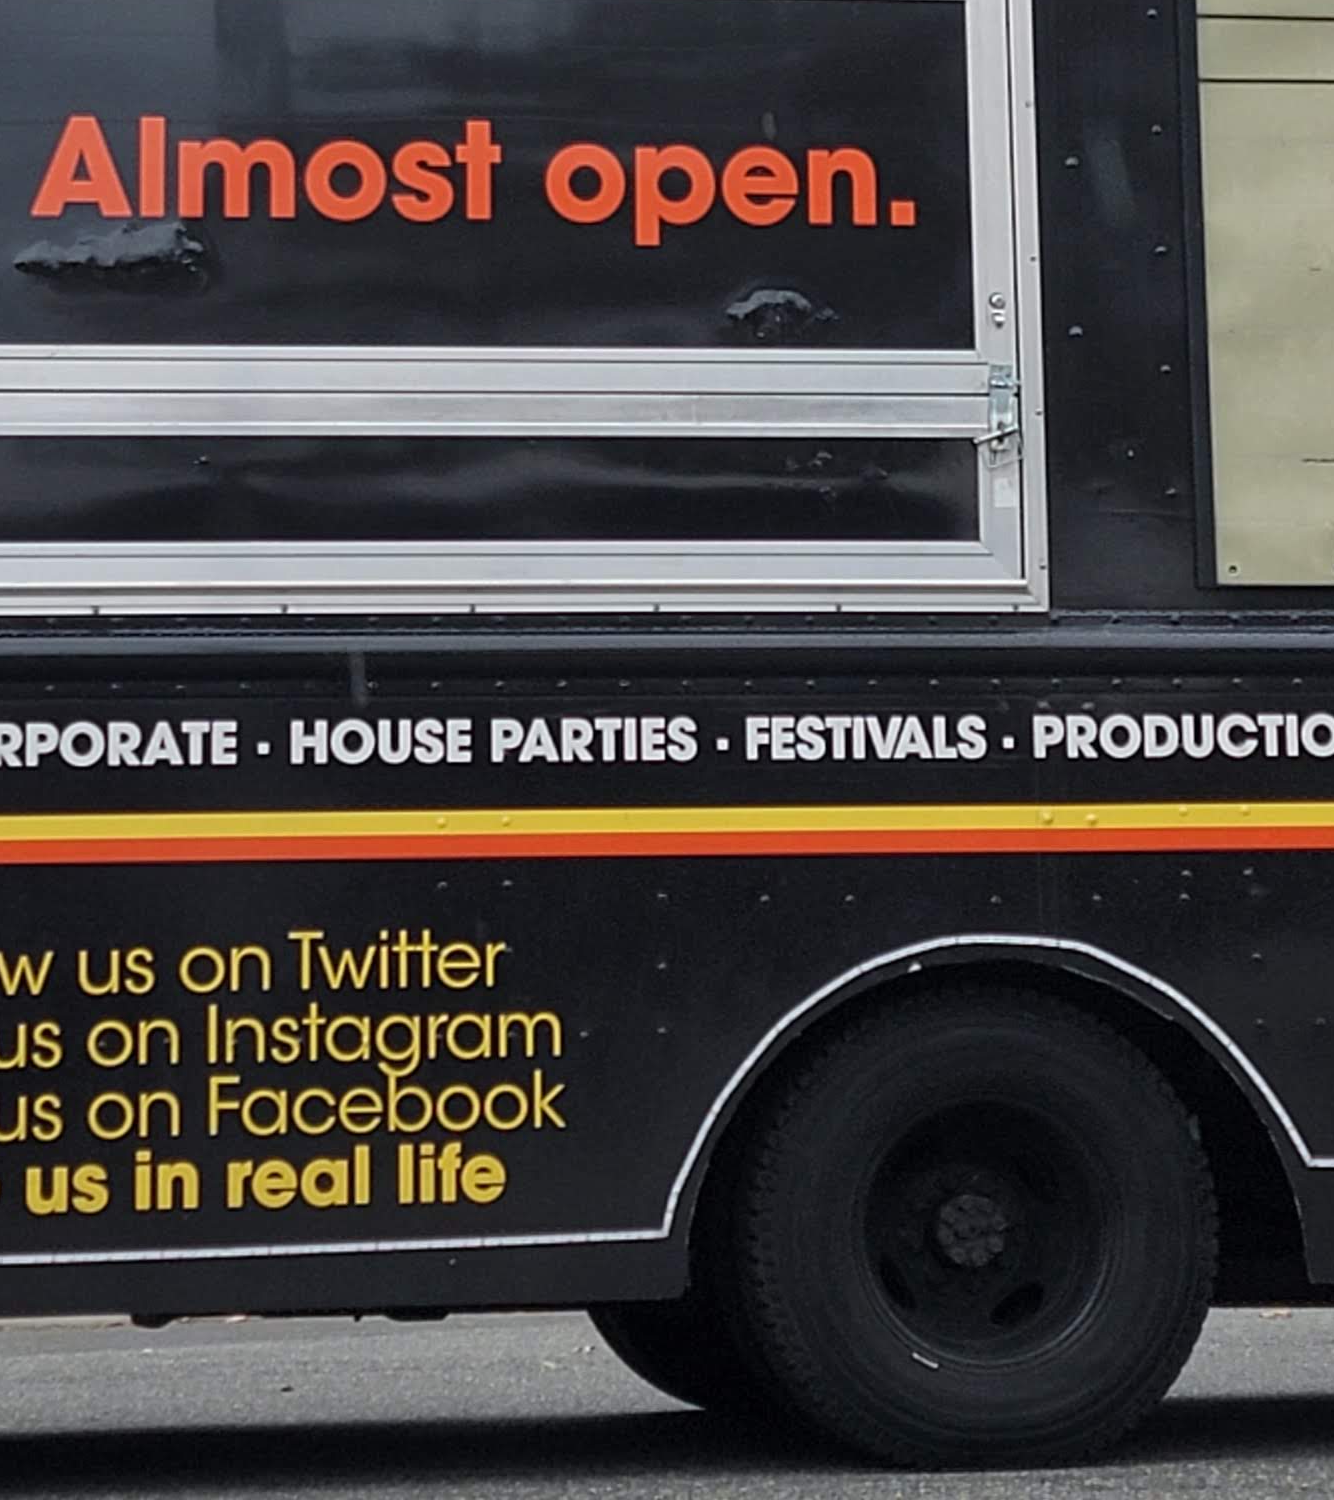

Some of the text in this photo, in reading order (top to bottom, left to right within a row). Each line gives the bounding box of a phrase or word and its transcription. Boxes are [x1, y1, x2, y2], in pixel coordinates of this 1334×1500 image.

[32, 114, 916, 246] Almost open.
[290, 718, 472, 765] HOUSE
[490, 716, 698, 763] PARTIES
[745, 714, 987, 761] FESTIVALS
[78, 947, 155, 996] us
[179, 945, 271, 993] on
[291, 928, 505, 990] Twitter
[86, 1019, 179, 1067] on
[208, 1001, 562, 1078] Instagram
[87, 1091, 180, 1140] on
[209, 1070, 565, 1136] Facebook
[25, 1163, 109, 1215] us
[134, 1149, 199, 1211] in
[227, 1144, 370, 1209] real
[398, 1141, 506, 1204] life
